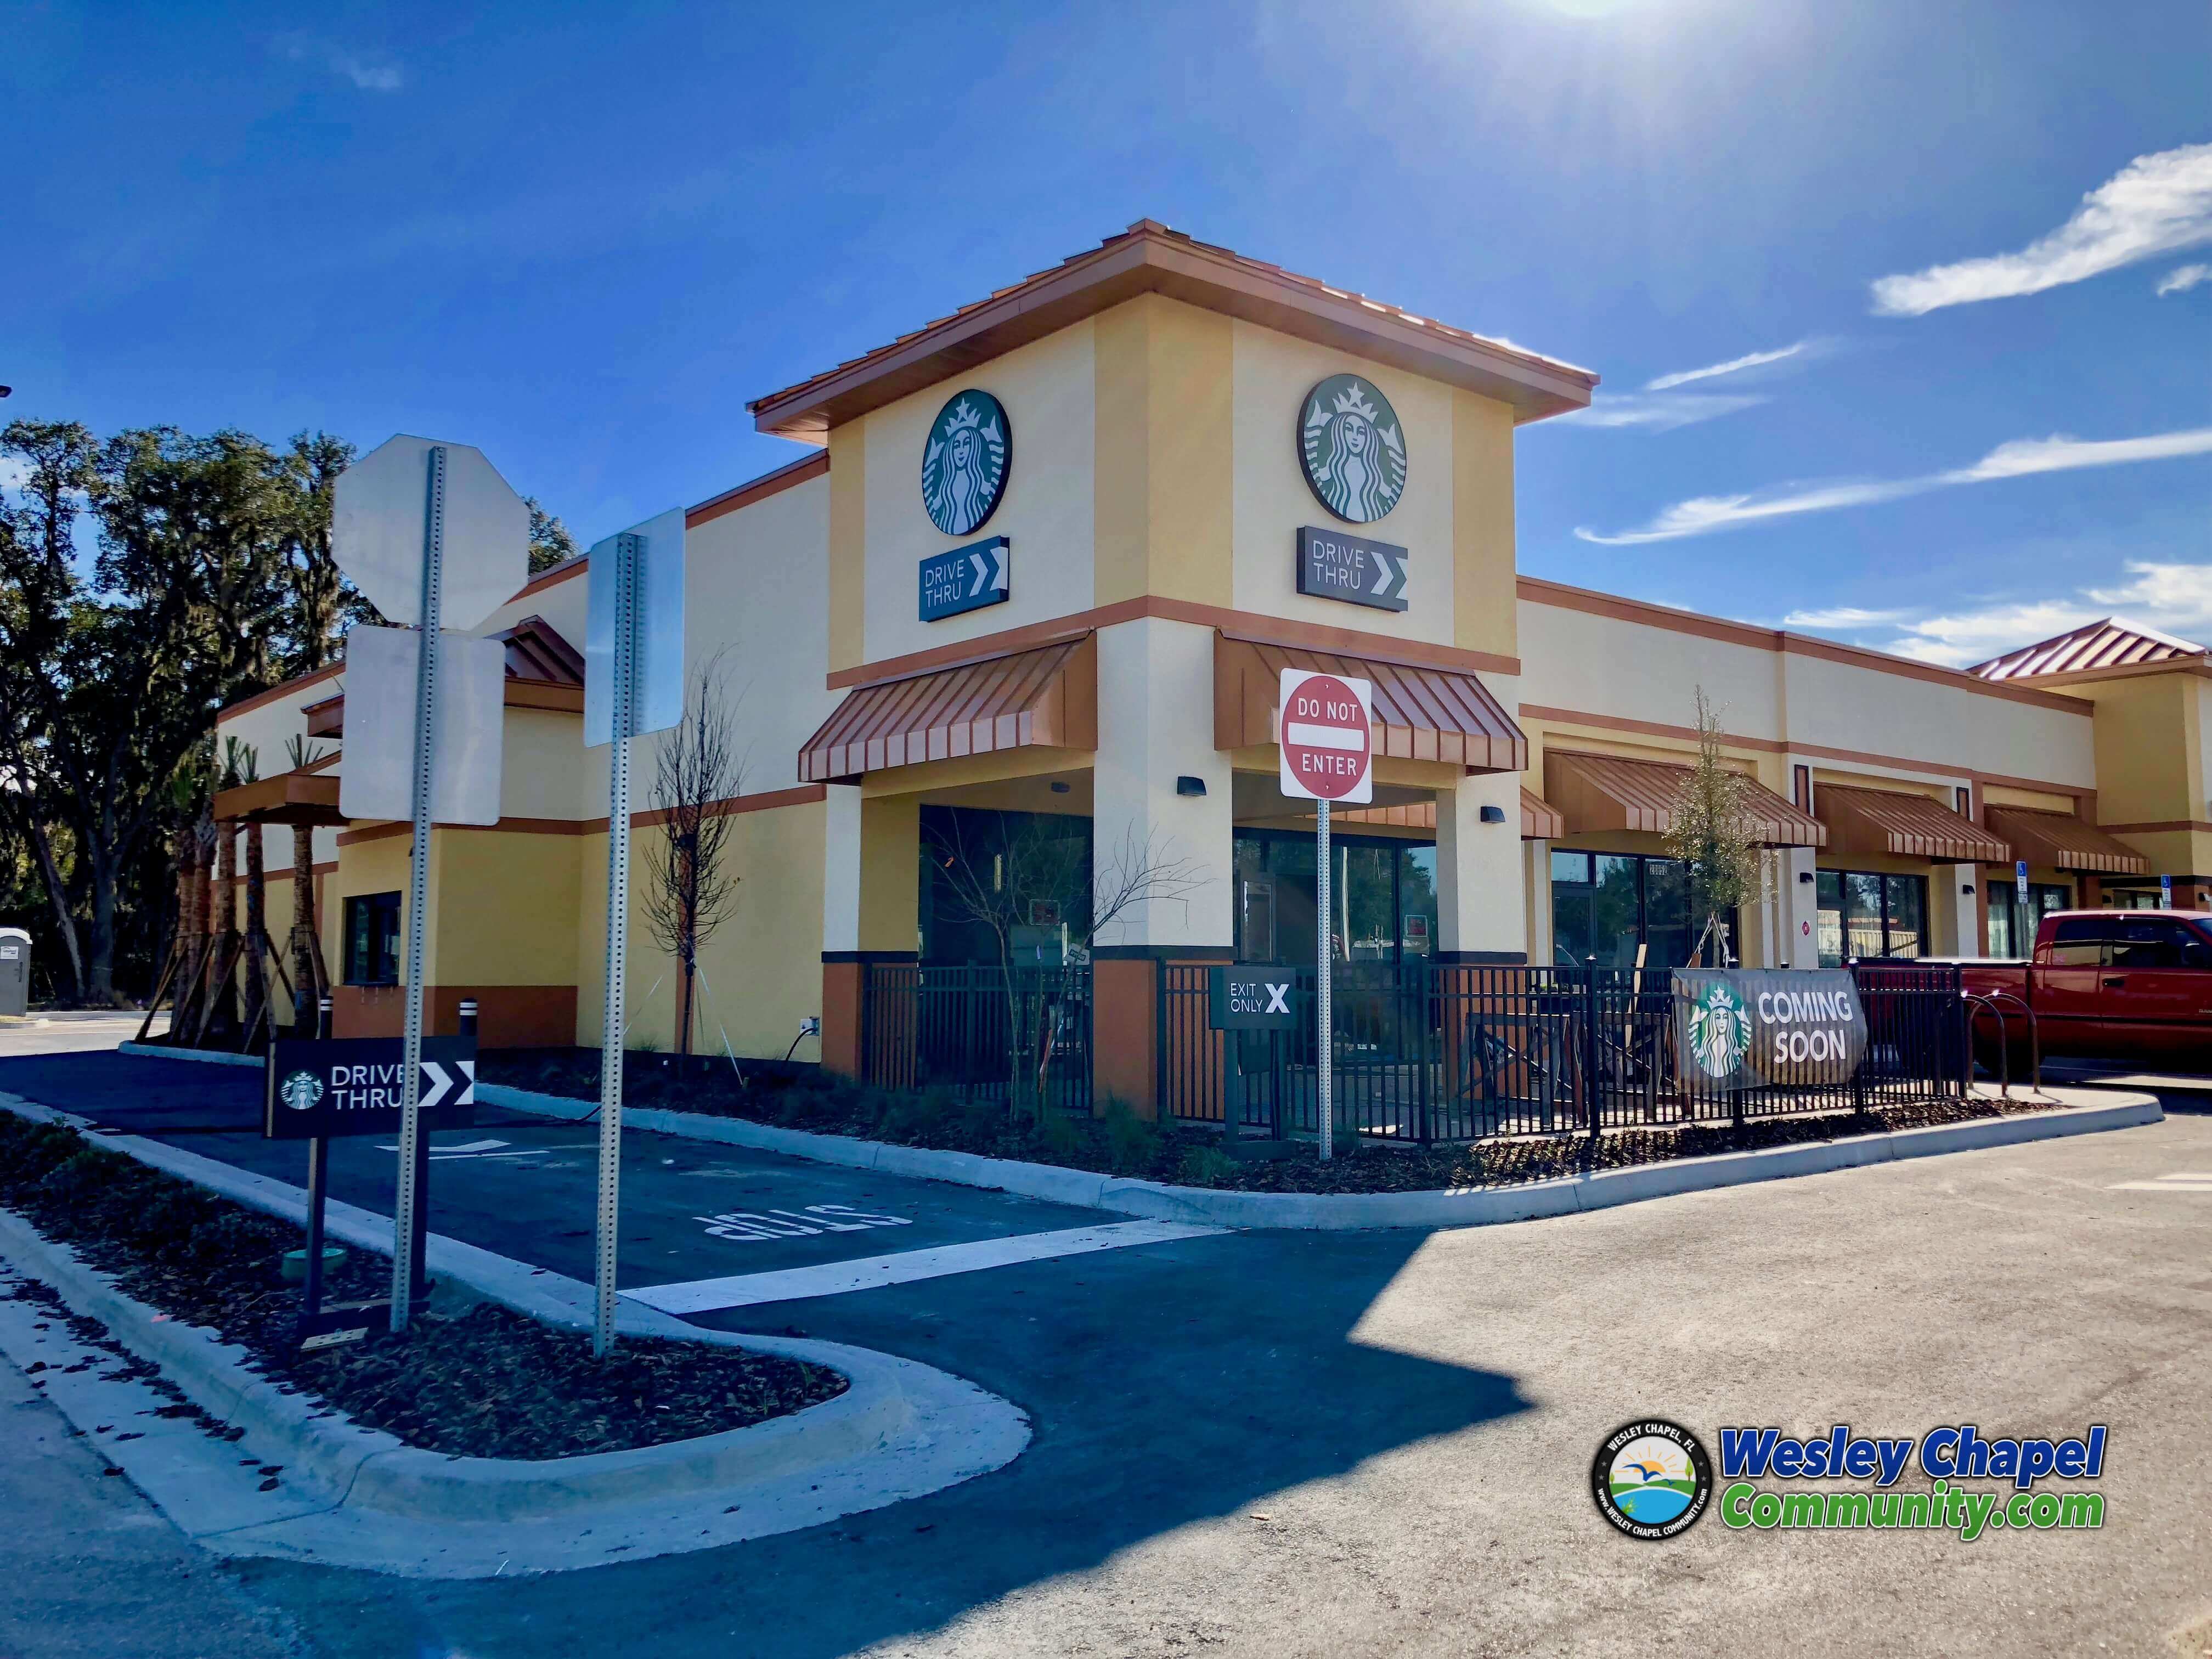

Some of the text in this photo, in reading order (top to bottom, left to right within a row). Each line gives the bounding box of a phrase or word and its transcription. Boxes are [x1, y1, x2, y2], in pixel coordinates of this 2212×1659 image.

[1313, 540, 1364, 569] DRIVE
[926, 559, 964, 588] DRIVE
[1313, 562, 1361, 590] THRU
[926, 582, 961, 608] THRU
[1298, 697, 1358, 722] DO NOT
[1302, 753, 1357, 776] ENTER
[1231, 983, 1256, 997] EXIT
[1231, 998, 1263, 1013] ONLY
[1758, 991, 1853, 1024] COMING
[1774, 1030, 1846, 1063] SOON
[331, 1064, 404, 1086] DRIVE
[331, 1088, 403, 1110] THRU
[692, 1205, 913, 1240] STOP
